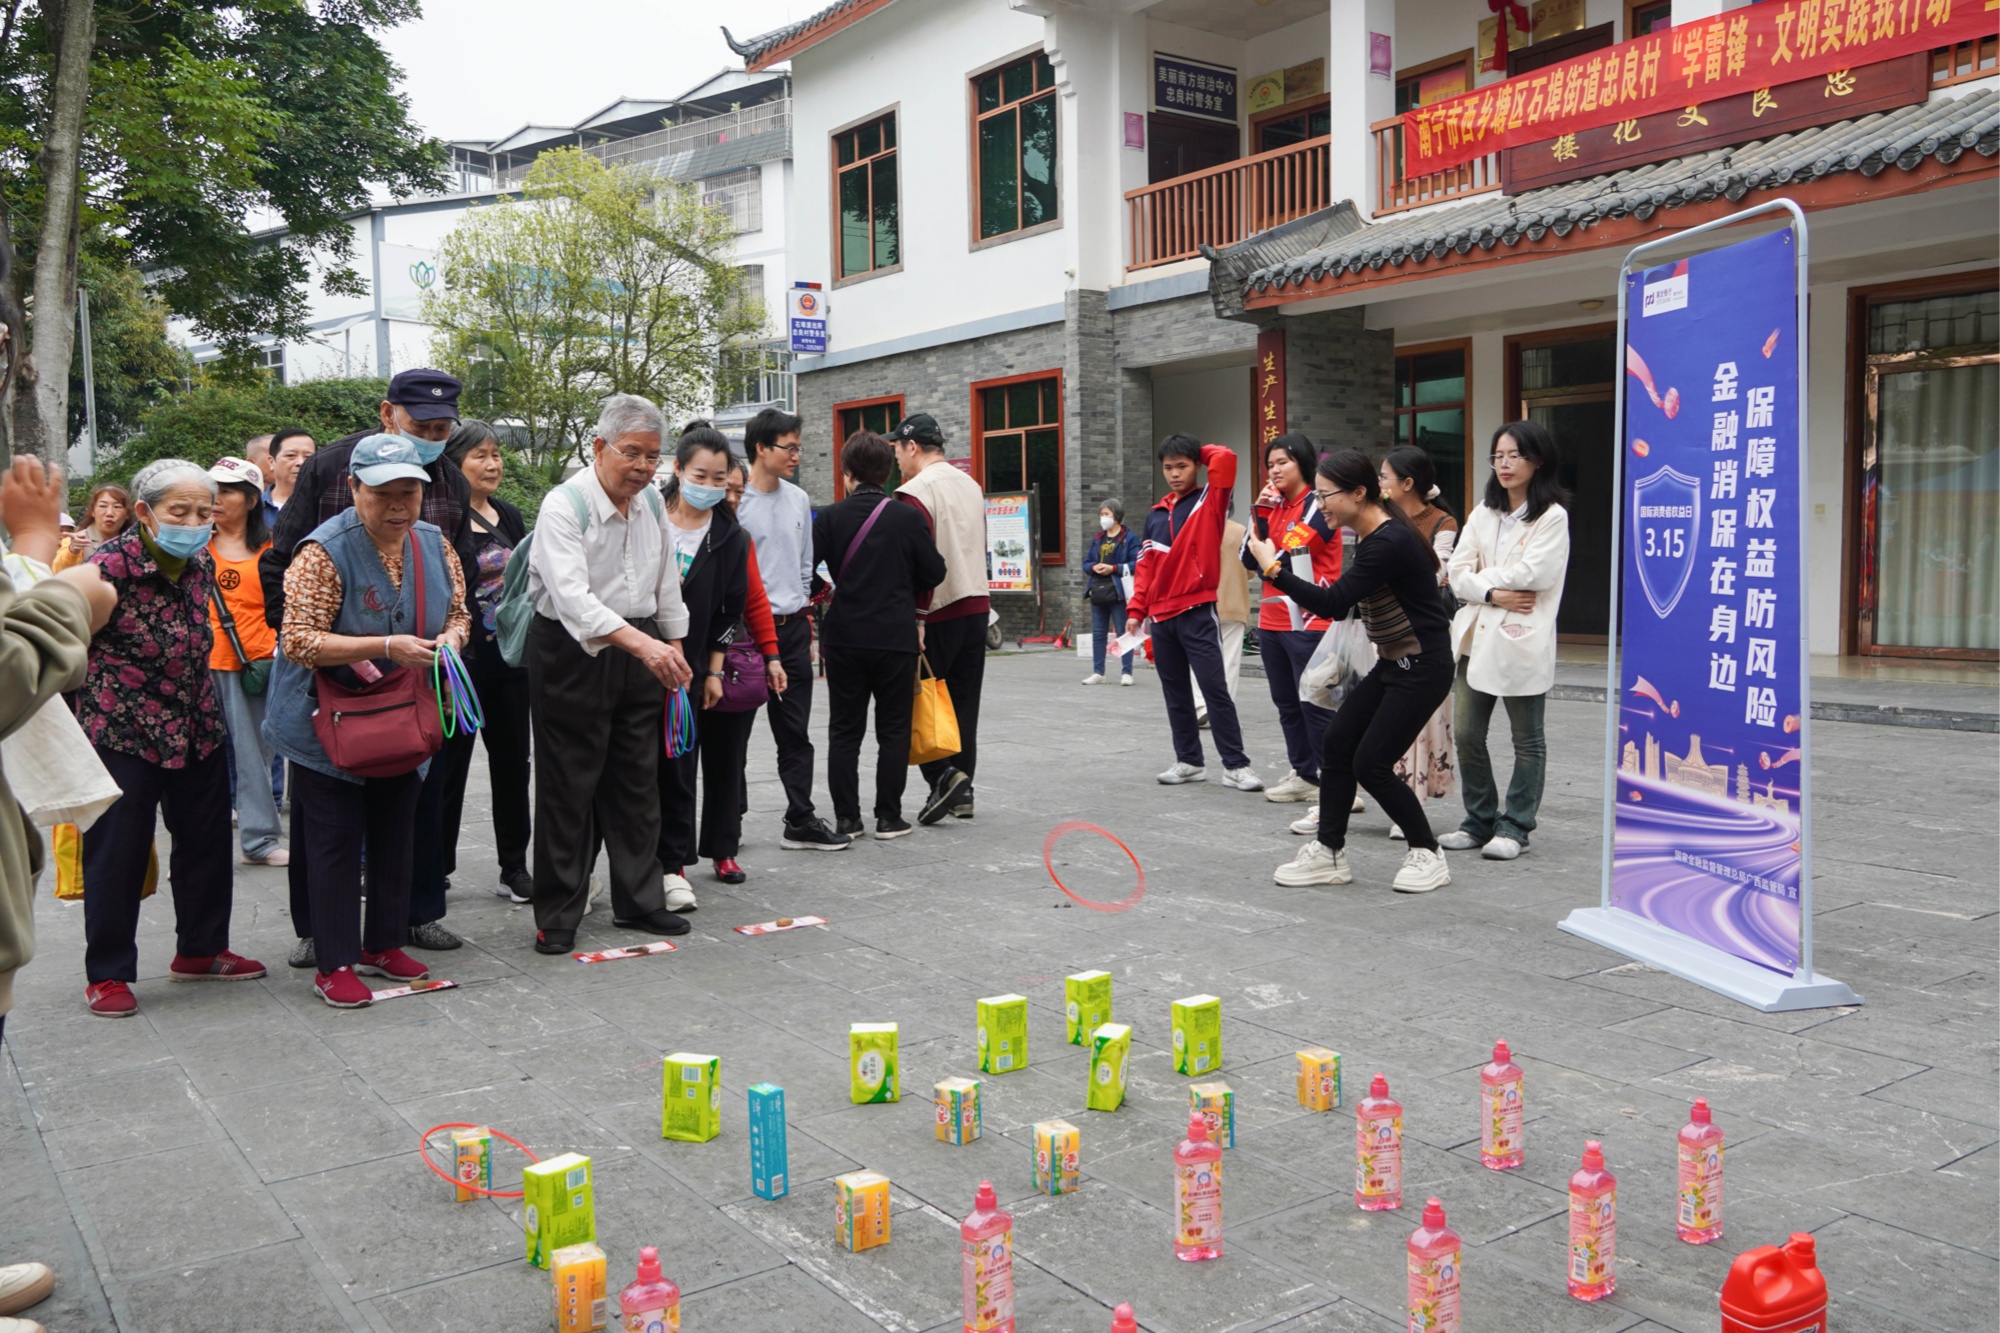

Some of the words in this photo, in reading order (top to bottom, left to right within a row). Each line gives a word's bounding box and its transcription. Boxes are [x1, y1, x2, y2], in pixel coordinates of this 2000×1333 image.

[1158, 65, 1234, 96] 美丽南方综治中心
[1166, 86, 1223, 112] 忠良村警务室
[1640, 505, 1692, 518] 国际消费者权益日
[1709, 361, 1739, 692] 金融消保在身边
[1645, 527, 1685, 558] 3.15
[1744, 385, 1778, 728] 保障权益防风险
[1674, 849, 1785, 896] 国家金融监督管理总局广西监管局
[1787, 886, 1798, 900] 宣
